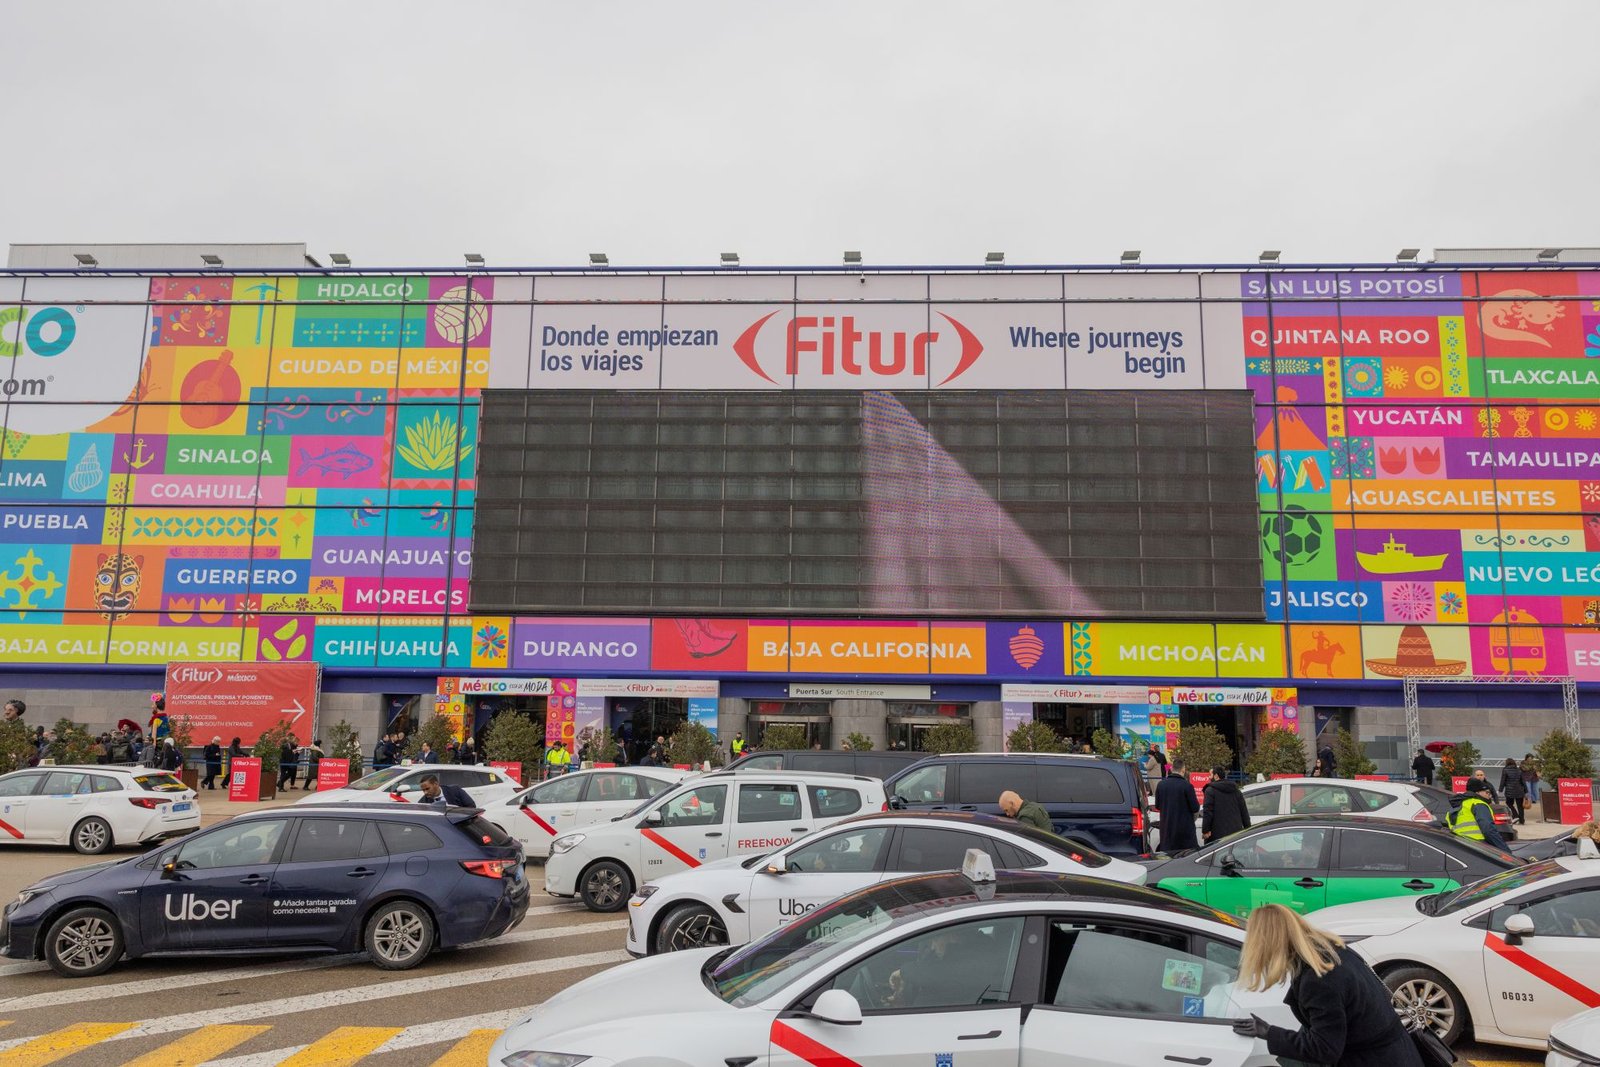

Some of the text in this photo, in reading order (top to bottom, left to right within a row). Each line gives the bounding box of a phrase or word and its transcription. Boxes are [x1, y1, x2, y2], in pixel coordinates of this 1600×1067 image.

[317, 281, 413, 298] HIDALGO
[1248, 275, 1445, 294] SAN LUIS POTOSÍ
[542, 325, 718, 351] Donde empiezan
[785, 316, 940, 376] Fitur
[1009, 326, 1184, 354] Where journeys
[1250, 328, 1430, 347] QUINTANA ROO
[279, 357, 489, 375] CIUDAD DE MÉXICO
[540, 349, 643, 377] los viajes
[1125, 352, 1186, 379] begin
[1486, 368, 1600, 385] TLAXCALA
[1353, 406, 1463, 425] YUCATÁN
[178, 448, 273, 464] SINALOA
[150, 483, 263, 499] COAHUILA
[1345, 489, 1557, 506] AGUASCALIENTES
[3, 513, 89, 529] PUEBLA
[177, 569, 298, 585] GUERRERO
[1469, 566, 1553, 583] NUEVO
[356, 588, 463, 605] MORELOS
[1270, 590, 1368, 608] JALISCO
[56, 639, 192, 657] CALIFORNIA
[197, 641, 241, 658] SUR
[324, 640, 460, 656] CHIHUAHUA
[523, 641, 638, 658] DURANGO
[763, 641, 972, 659] BAJA CALIFORNIA
[1119, 642, 1265, 662] MICHOACÁN
[181, 666, 215, 682] Fitur
[462, 679, 507, 692] MÉXICO
[523, 679, 548, 693] MODA
[632, 683, 650, 692] Fitur
[796, 688, 820, 696] Puerta
[836, 688, 856, 696] South
[856, 689, 884, 697] Entrance
[1059, 689, 1078, 698] Fitur
[1177, 690, 1225, 702] MÉXICO
[1242, 691, 1268, 703] MODA
[737, 837, 794, 849] FREENOW
[165, 893, 243, 921] Uber
[281, 899, 305, 907] Añade
[328, 898, 357, 907] paradas
[778, 898, 820, 916] Ube
[1501, 991, 1535, 1002] 06033
